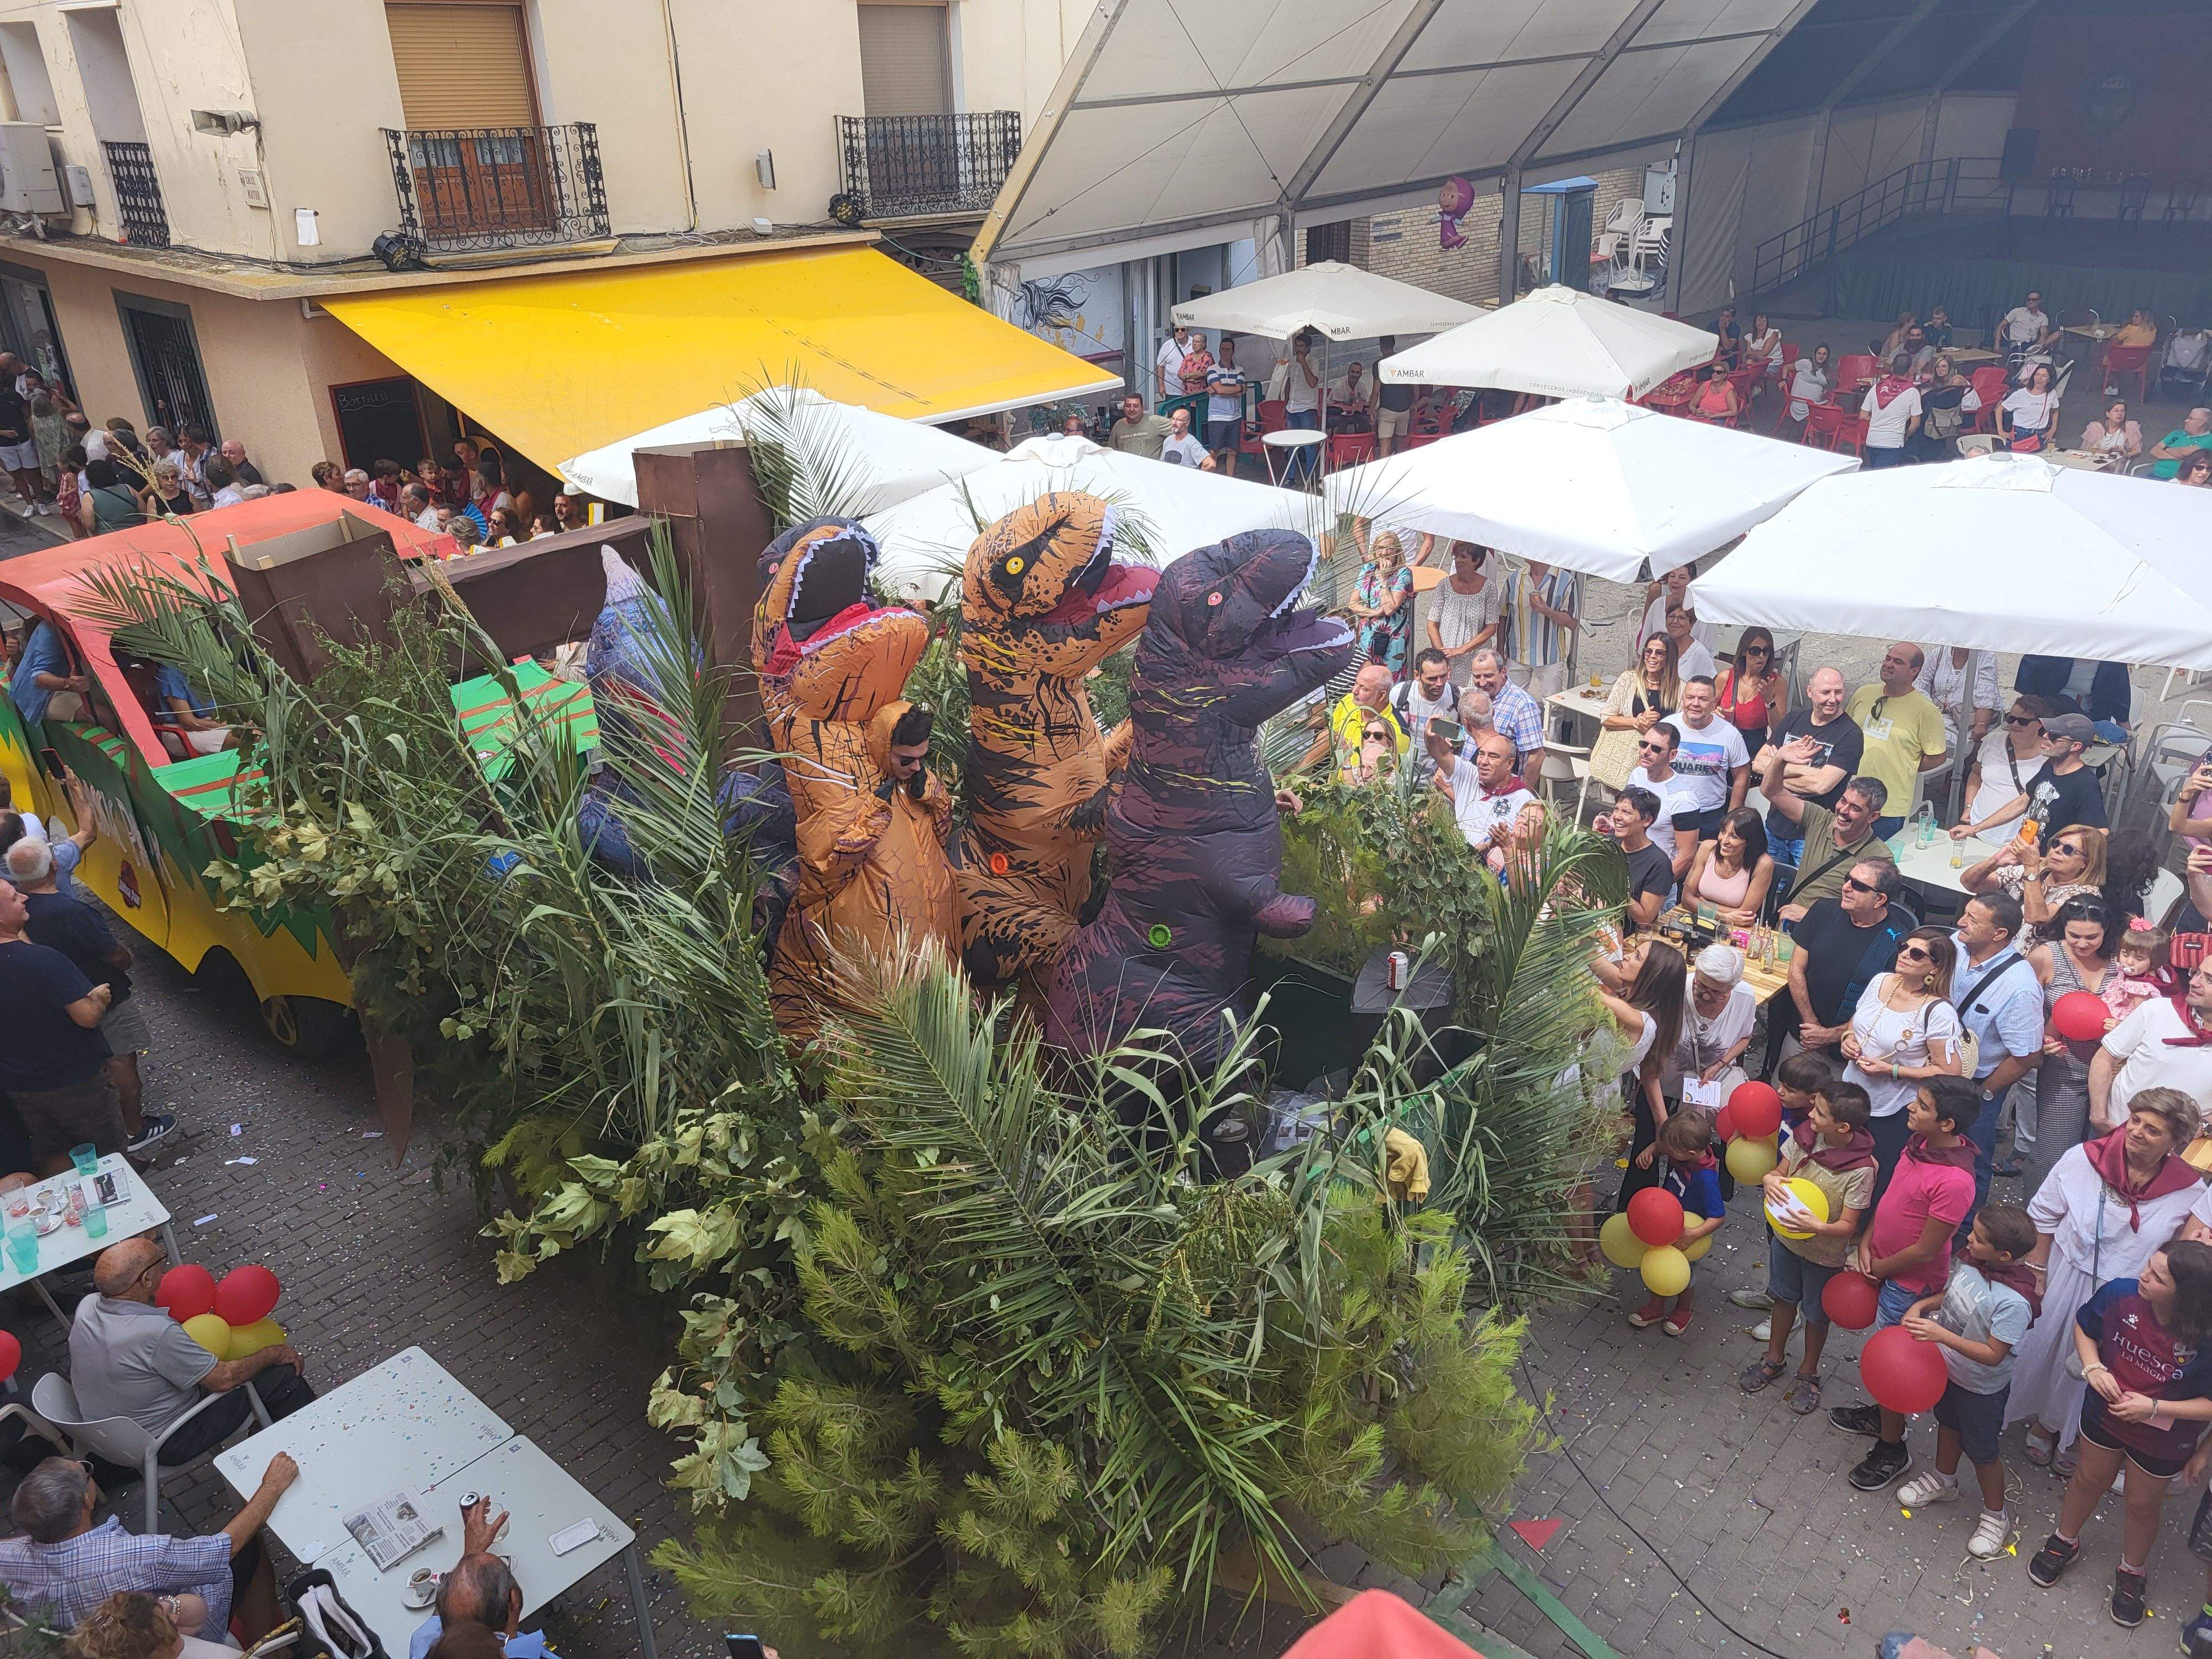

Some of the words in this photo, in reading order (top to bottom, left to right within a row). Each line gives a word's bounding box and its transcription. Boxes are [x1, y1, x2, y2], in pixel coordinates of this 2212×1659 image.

[1179, 313, 1195, 321] AMBAR
[1331, 326, 1351, 336] MBAR
[1396, 369, 1425, 378] AMBAR
[1530, 383, 1565, 392] CERVECEROS
[1638, 377, 1651, 393] AMBAR
[569, 473, 593, 487] AMBAR
[1670, 761, 1710, 773] QUARE
[2112, 1331, 2183, 1380] Huesca
[2121, 1351, 2133, 1363] La
[479, 1423, 498, 1440] AMBAR
[227, 1454, 247, 1472] AMBAR
[599, 1524, 622, 1543] AMBAR
[330, 1557, 351, 1577] AMBAR
